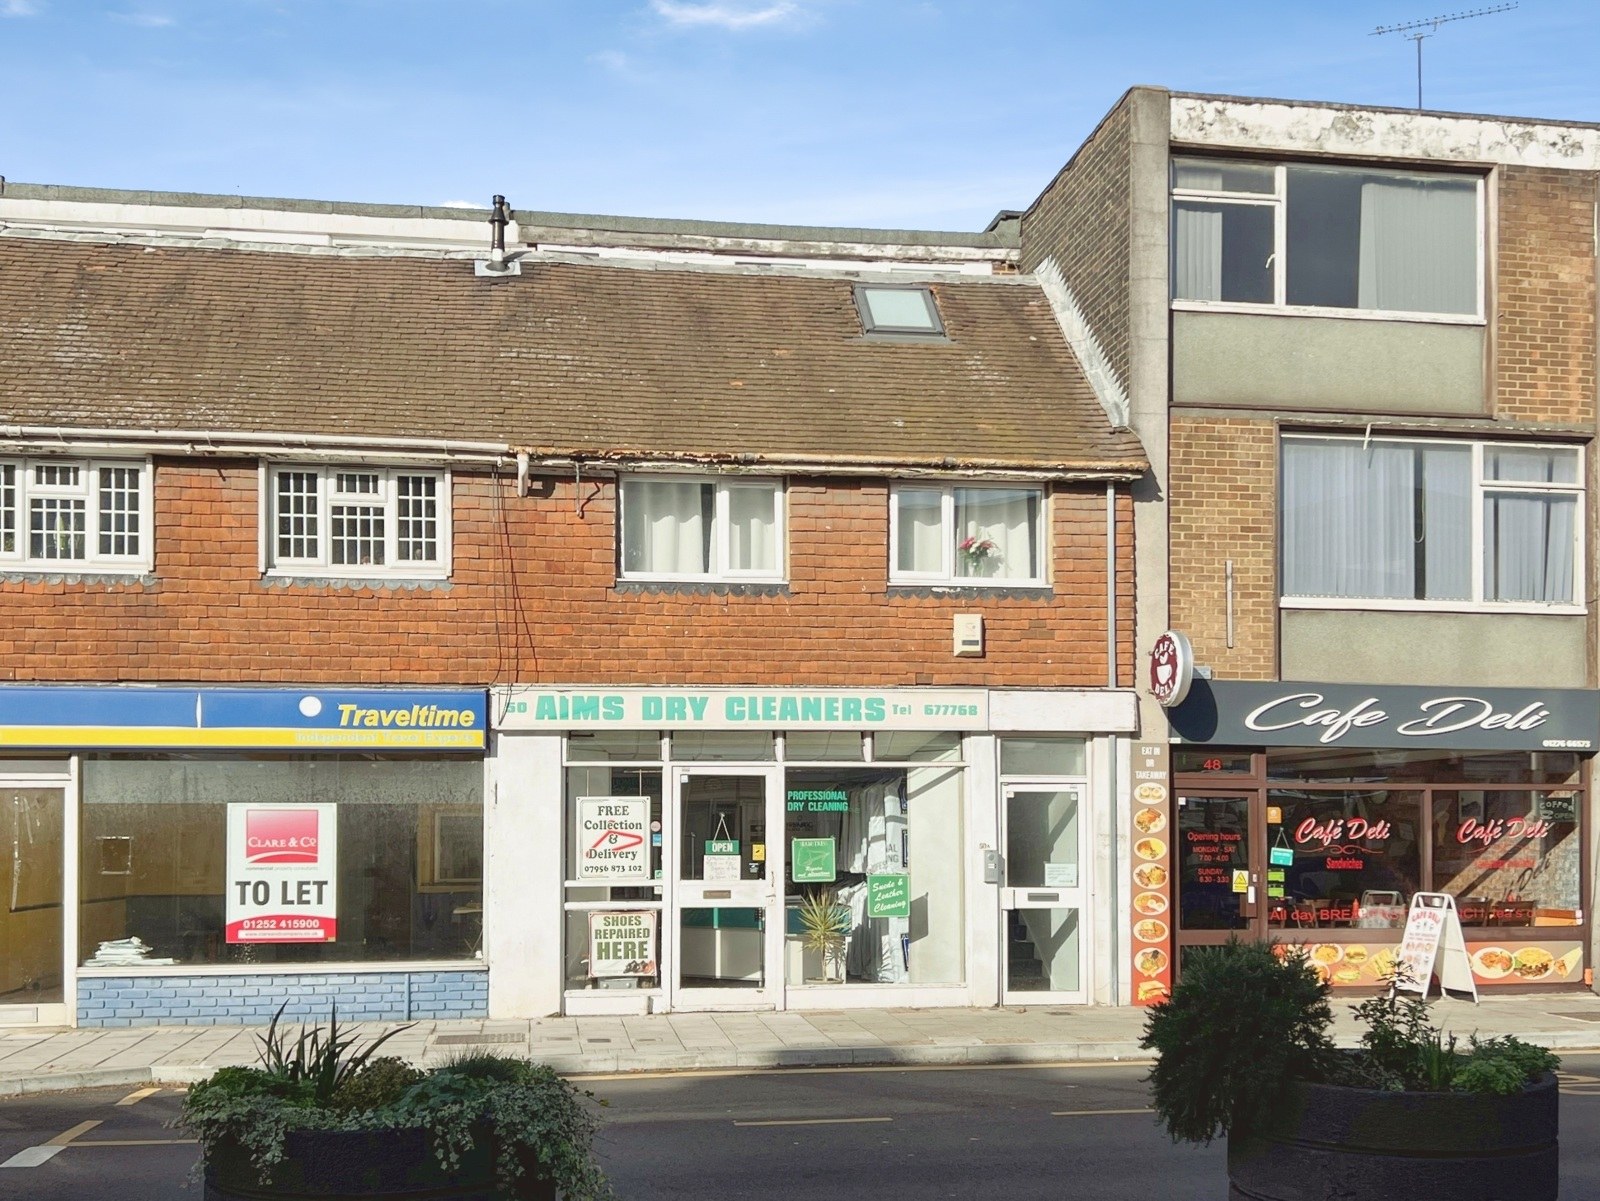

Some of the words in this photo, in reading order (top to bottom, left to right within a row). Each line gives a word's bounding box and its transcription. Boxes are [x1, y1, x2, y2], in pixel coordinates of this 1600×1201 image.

[1154, 641, 1175, 660] CAFE
[1155, 682, 1174, 697] DELI
[507, 702, 528, 714] 50
[535, 695, 625, 721] AIMS
[642, 696, 709, 721] DRY
[725, 696, 886, 722] CLEANERS
[892, 704, 912, 716] Tel
[924, 704, 978, 716] 677768
[338, 703, 475, 727] Traveltime
[1244, 693, 1389, 744] Cafe
[1397, 697, 1550, 736] Deli
[1141, 746, 1153, 756] EAT
[1154, 746, 1161, 756] IN
[1145, 758, 1155, 768] OR
[1204, 759, 1222, 771] 48
[1135, 770, 1167, 780] TAKEAWAY
[787, 791, 848, 801] PROFESSIONAL
[597, 805, 629, 816] FREE
[787, 802, 804, 811] DRY
[808, 802, 848, 811] CLEANING
[584, 820, 642, 830] Collection
[1187, 832, 1218, 842] Opening
[1220, 832, 1241, 841] hours
[1295, 817, 1344, 846] Café
[1347, 817, 1391, 839] Deli
[1457, 818, 1504, 846] Café
[1507, 817, 1549, 839] Deli
[248, 836, 286, 848] CLARE
[288, 836, 298, 848] &
[608, 834, 618, 844] &
[712, 842, 733, 853] OPEN
[589, 848, 637, 860] Delivery
[584, 865, 608, 873] 07956
[611, 865, 625, 873] 873
[1326, 857, 1363, 869] Sandwiches
[872, 880, 895, 893] Suede
[897, 878, 903, 886] &
[235, 880, 270, 906] TO
[281, 880, 328, 906] LET
[875, 890, 903, 902] Leather
[873, 900, 907, 913] Cleaning
[603, 915, 642, 927] SHOES
[1270, 909, 1287, 921] All
[1291, 908, 1316, 922] day
[243, 919, 276, 929] 01252
[280, 919, 320, 929] 415900
[594, 928, 650, 939] REPAIRED
[597, 941, 648, 960] HERE
